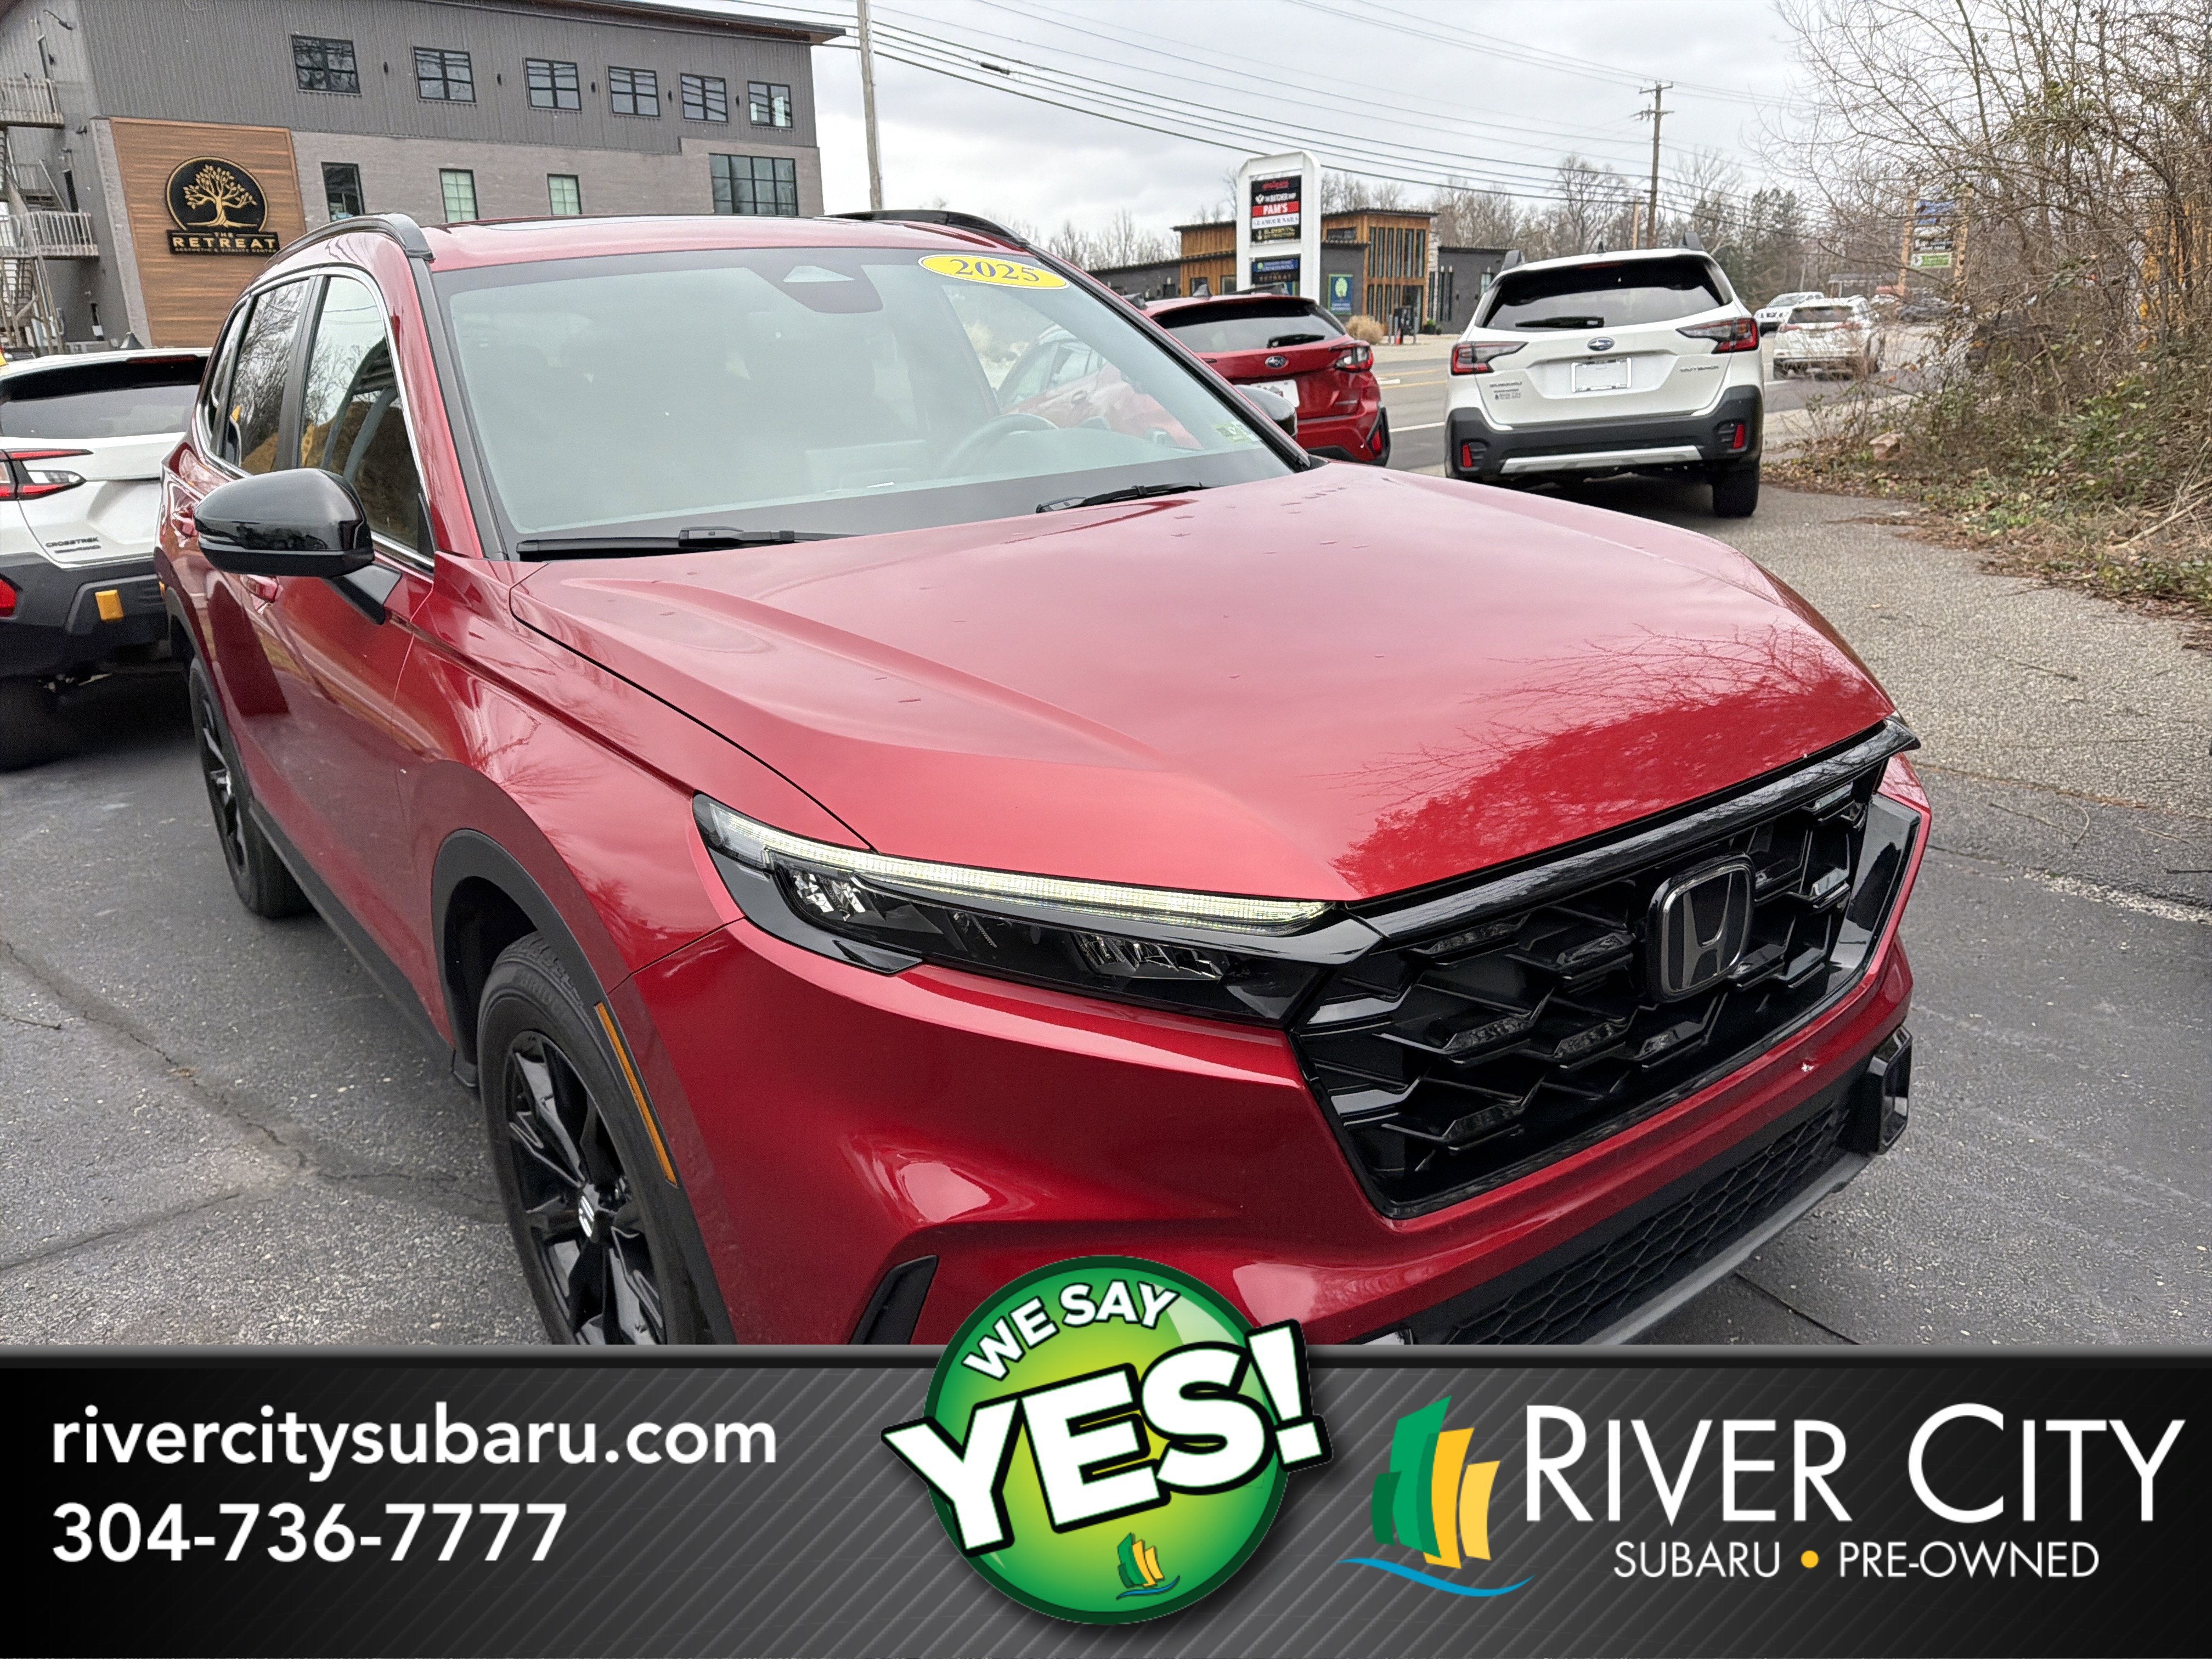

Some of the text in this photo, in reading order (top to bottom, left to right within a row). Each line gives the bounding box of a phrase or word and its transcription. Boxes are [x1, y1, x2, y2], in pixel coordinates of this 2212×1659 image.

[1263, 202, 1288, 215] PAM'S
[172, 237, 275, 249] RETREAT
[949, 258, 1040, 282] 2025
[45, 537, 99, 548] CROSSTREK
